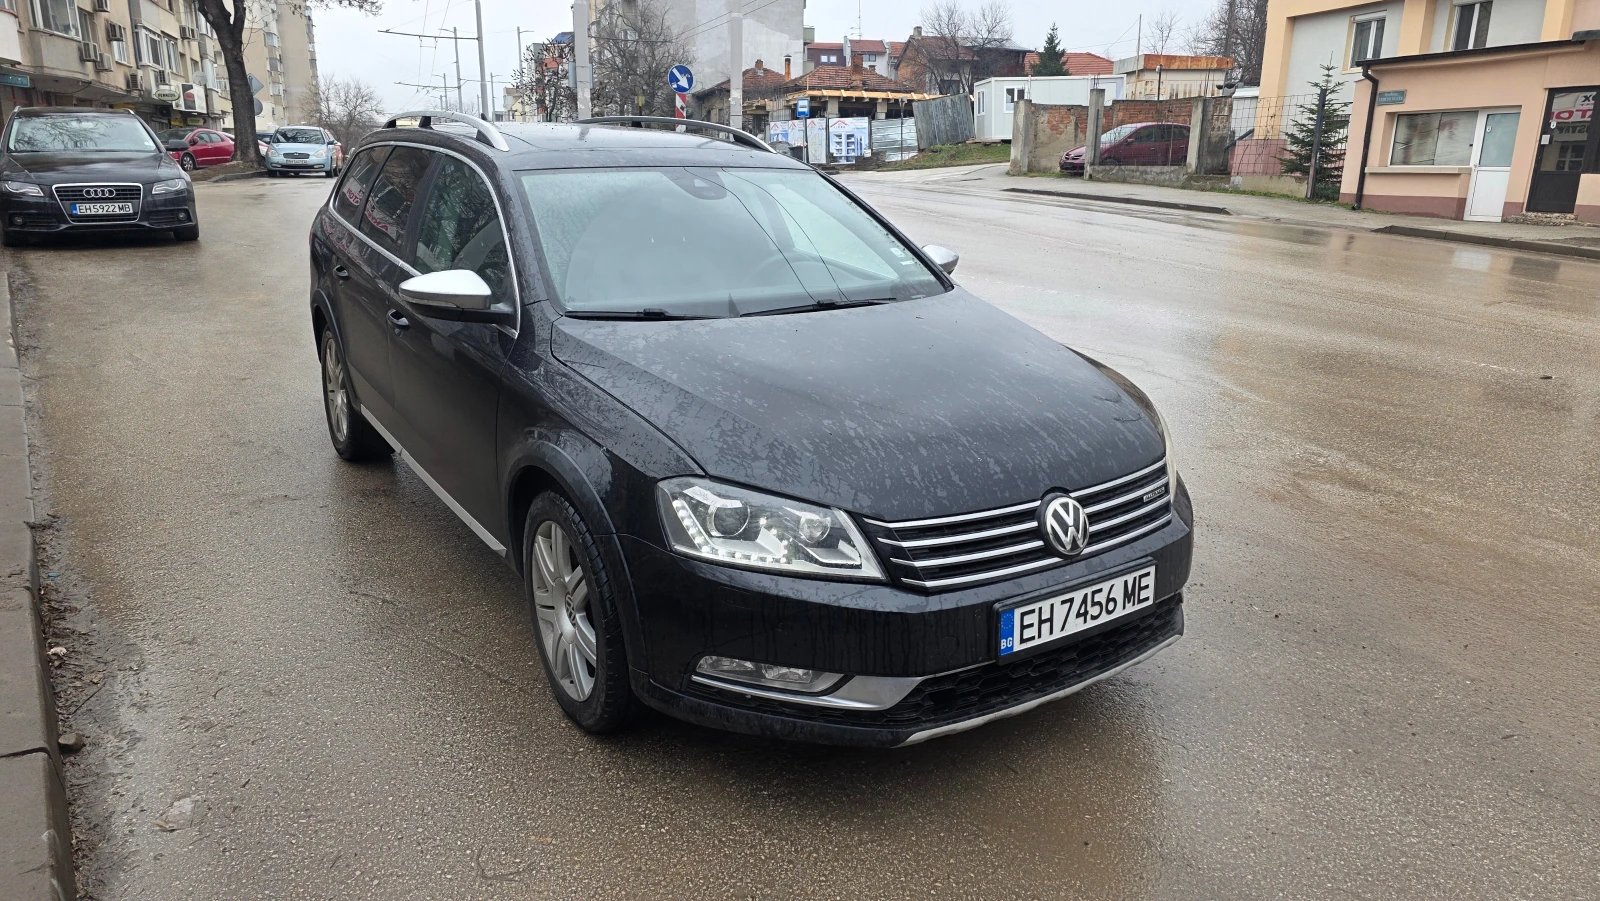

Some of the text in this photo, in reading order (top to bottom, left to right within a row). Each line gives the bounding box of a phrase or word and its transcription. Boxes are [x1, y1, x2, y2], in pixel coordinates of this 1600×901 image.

[78, 203, 131, 214] EH 5922 MB
[1019, 571, 1151, 645] EH 7456 ME
[1000, 637, 1013, 649] BG
